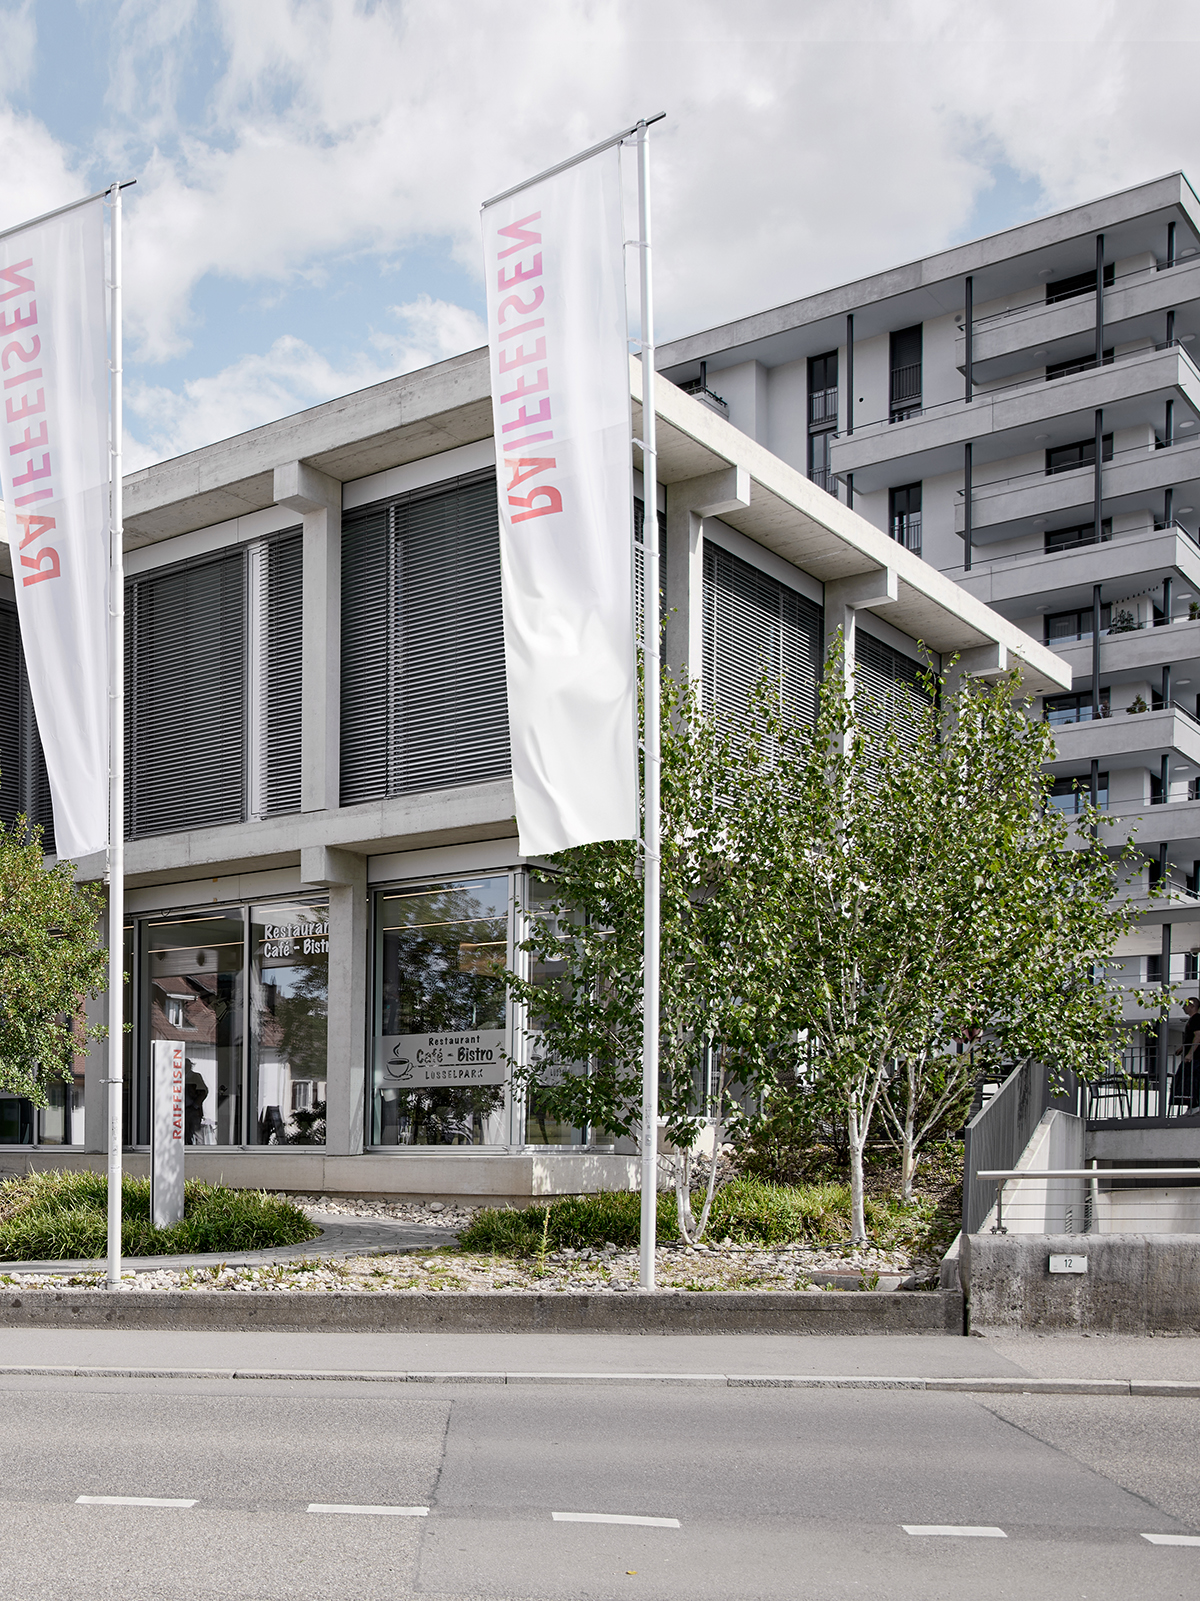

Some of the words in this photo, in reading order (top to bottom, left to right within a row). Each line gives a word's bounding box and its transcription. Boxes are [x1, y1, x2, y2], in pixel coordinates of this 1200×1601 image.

[264, 921, 329, 940] Restauran
[264, 941, 290, 958] Café
[303, 938, 329, 955] Bistr
[428, 1035, 481, 1046] Restaurant
[416, 1048, 443, 1063] Café
[457, 1046, 493, 1062] Bistro
[172, 1049, 182, 1140] RAIFFEISEN
[1064, 1259, 1073, 1268] 12
